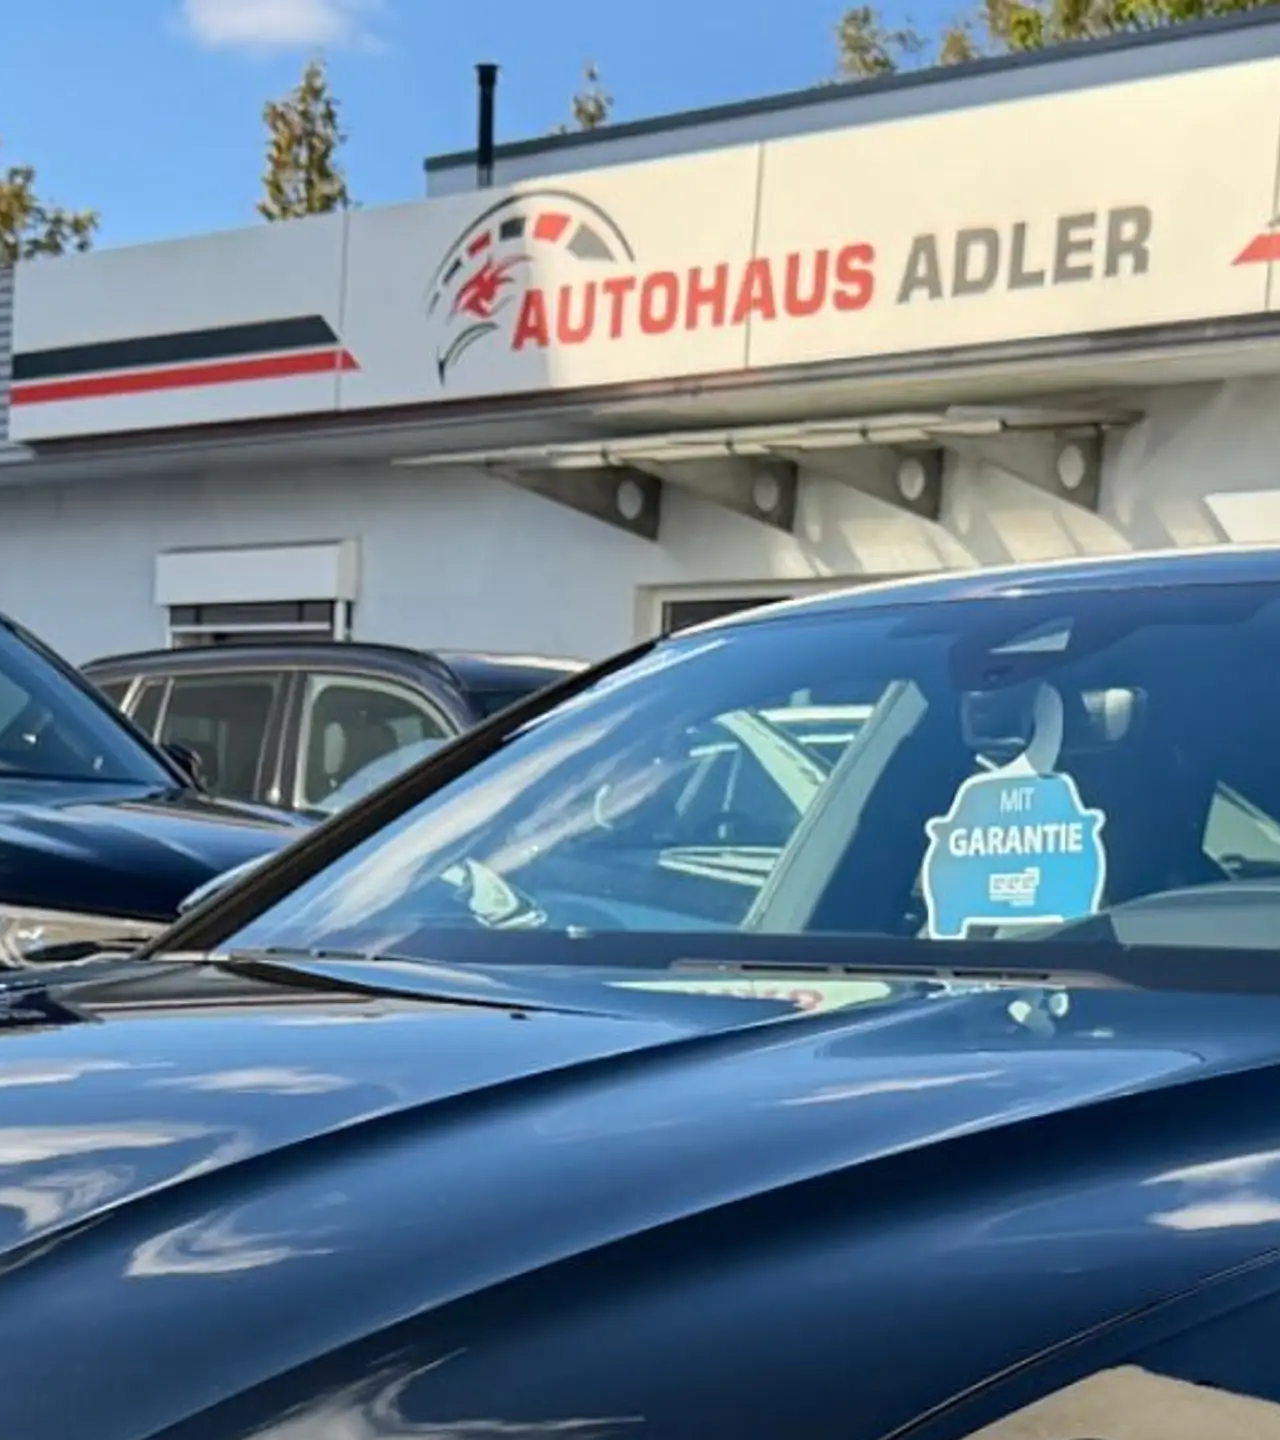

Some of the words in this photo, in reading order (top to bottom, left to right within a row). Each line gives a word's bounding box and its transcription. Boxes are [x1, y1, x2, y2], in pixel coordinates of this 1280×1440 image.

[510, 242, 875, 350] AUTOHAUS
[895, 204, 1153, 304] ADLER
[999, 786, 1036, 816] MIT
[948, 822, 1084, 858] GARANTIE
